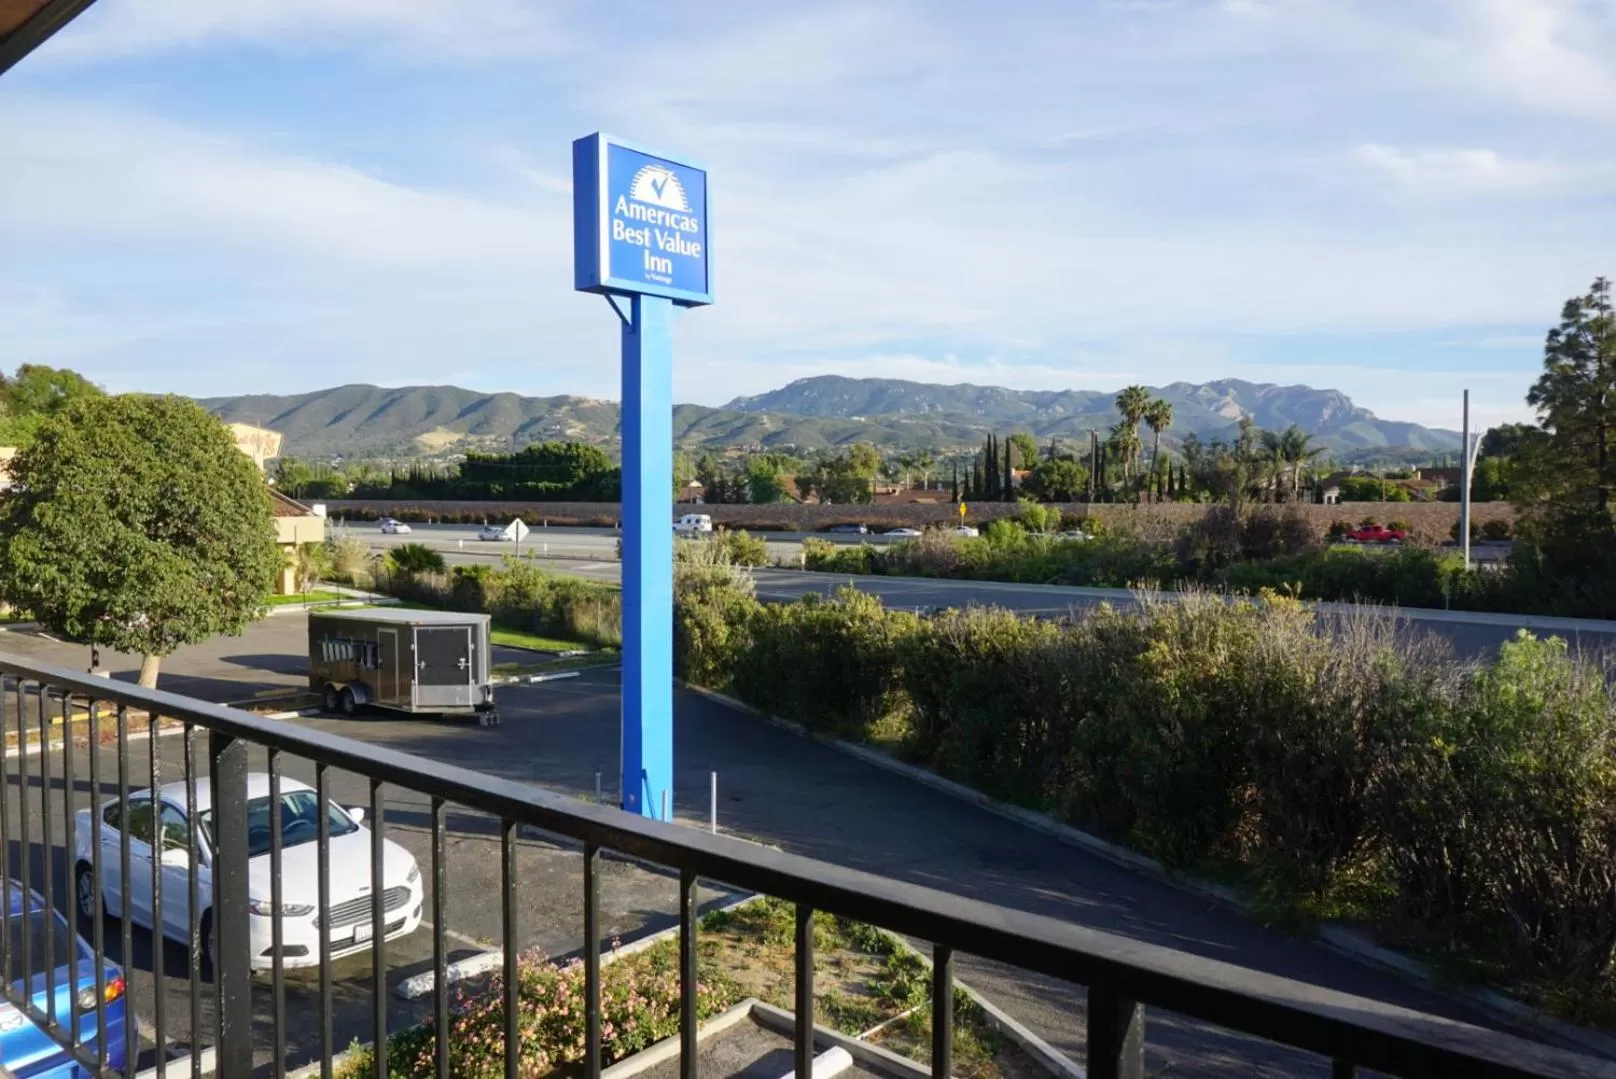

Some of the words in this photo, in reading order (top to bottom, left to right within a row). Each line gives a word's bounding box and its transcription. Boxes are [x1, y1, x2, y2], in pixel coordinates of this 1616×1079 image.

[615, 194, 698, 233] Americas
[613, 219, 650, 247] Best
[654, 228, 701, 258] Value
[644, 250, 672, 274] Inn
